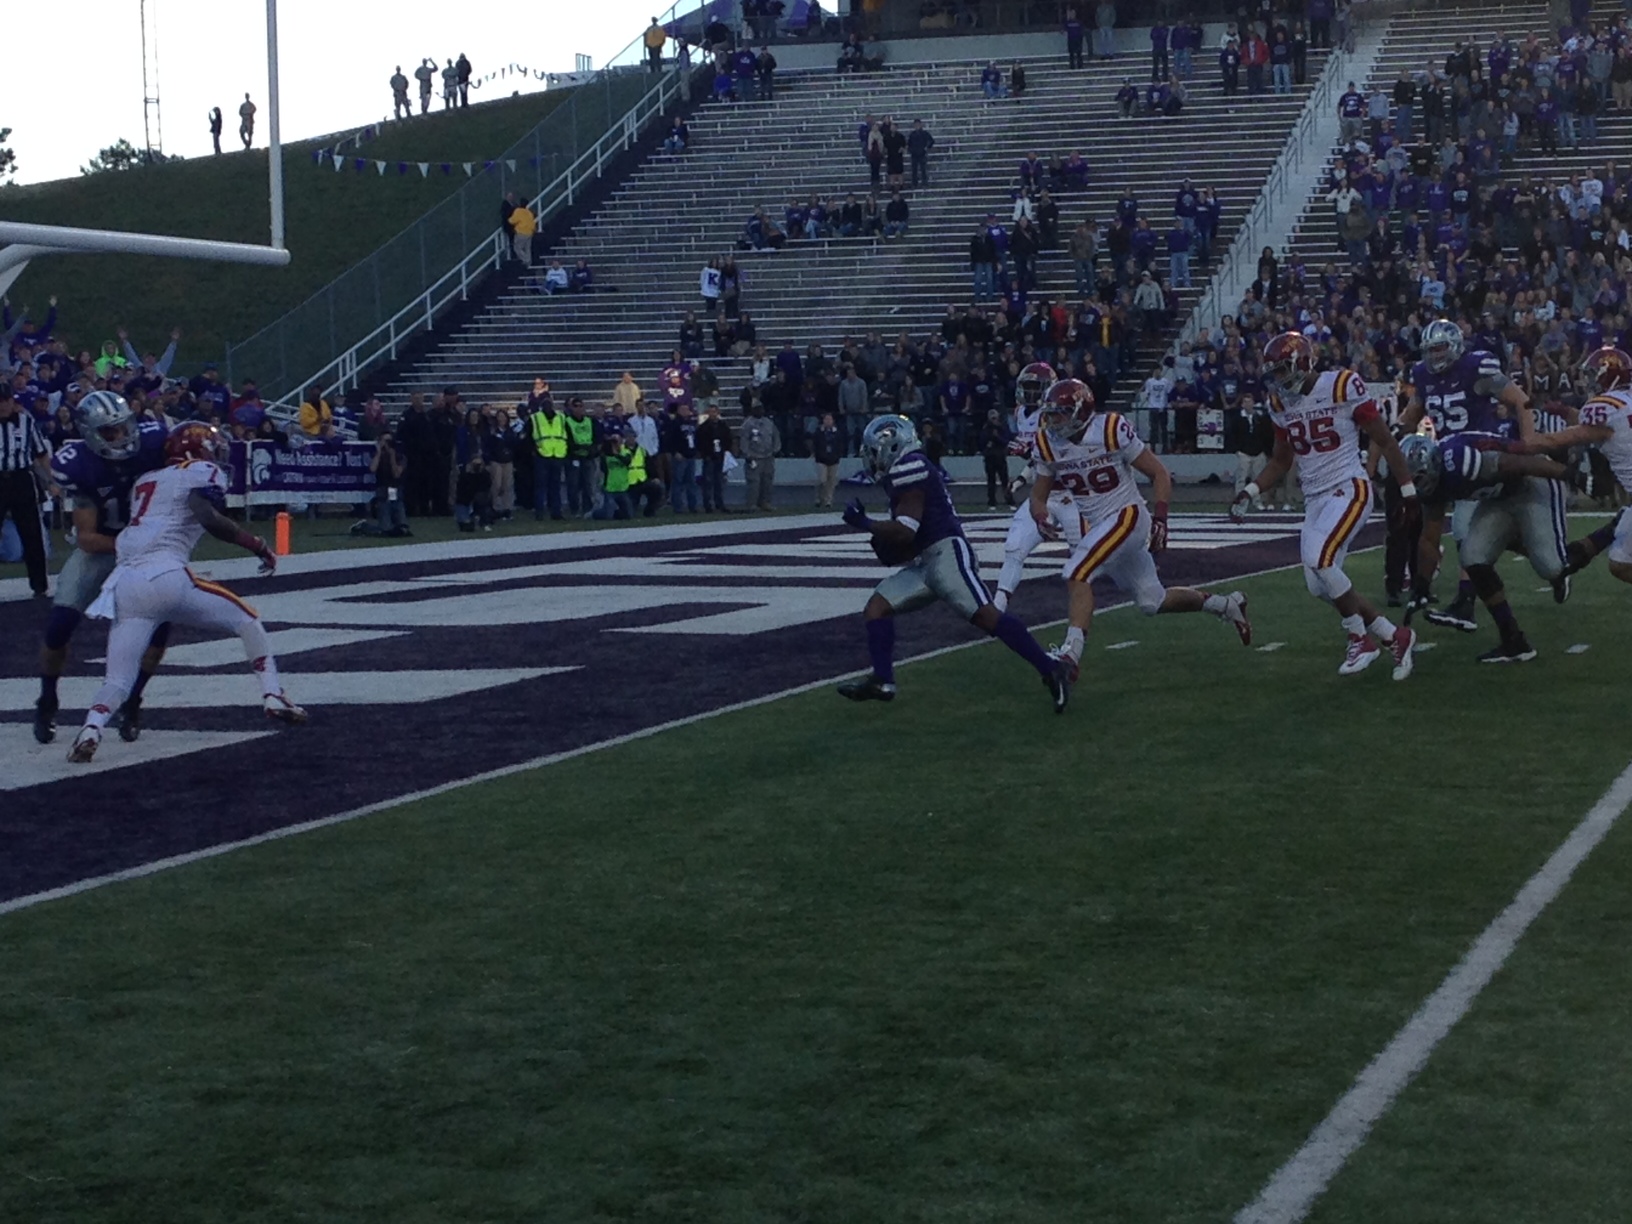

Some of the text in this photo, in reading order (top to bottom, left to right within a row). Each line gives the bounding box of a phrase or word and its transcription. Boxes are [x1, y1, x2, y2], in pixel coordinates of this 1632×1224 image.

[1533, 374, 1550, 391] M
[1557, 371, 1572, 390] A
[1424, 390, 1468, 432] 65
[1582, 406, 1607, 427] 35
[1287, 416, 1341, 456] 85
[1060, 465, 1121, 497] 29
[103, 497, 127, 530] 1
[131, 480, 158, 527] 7
